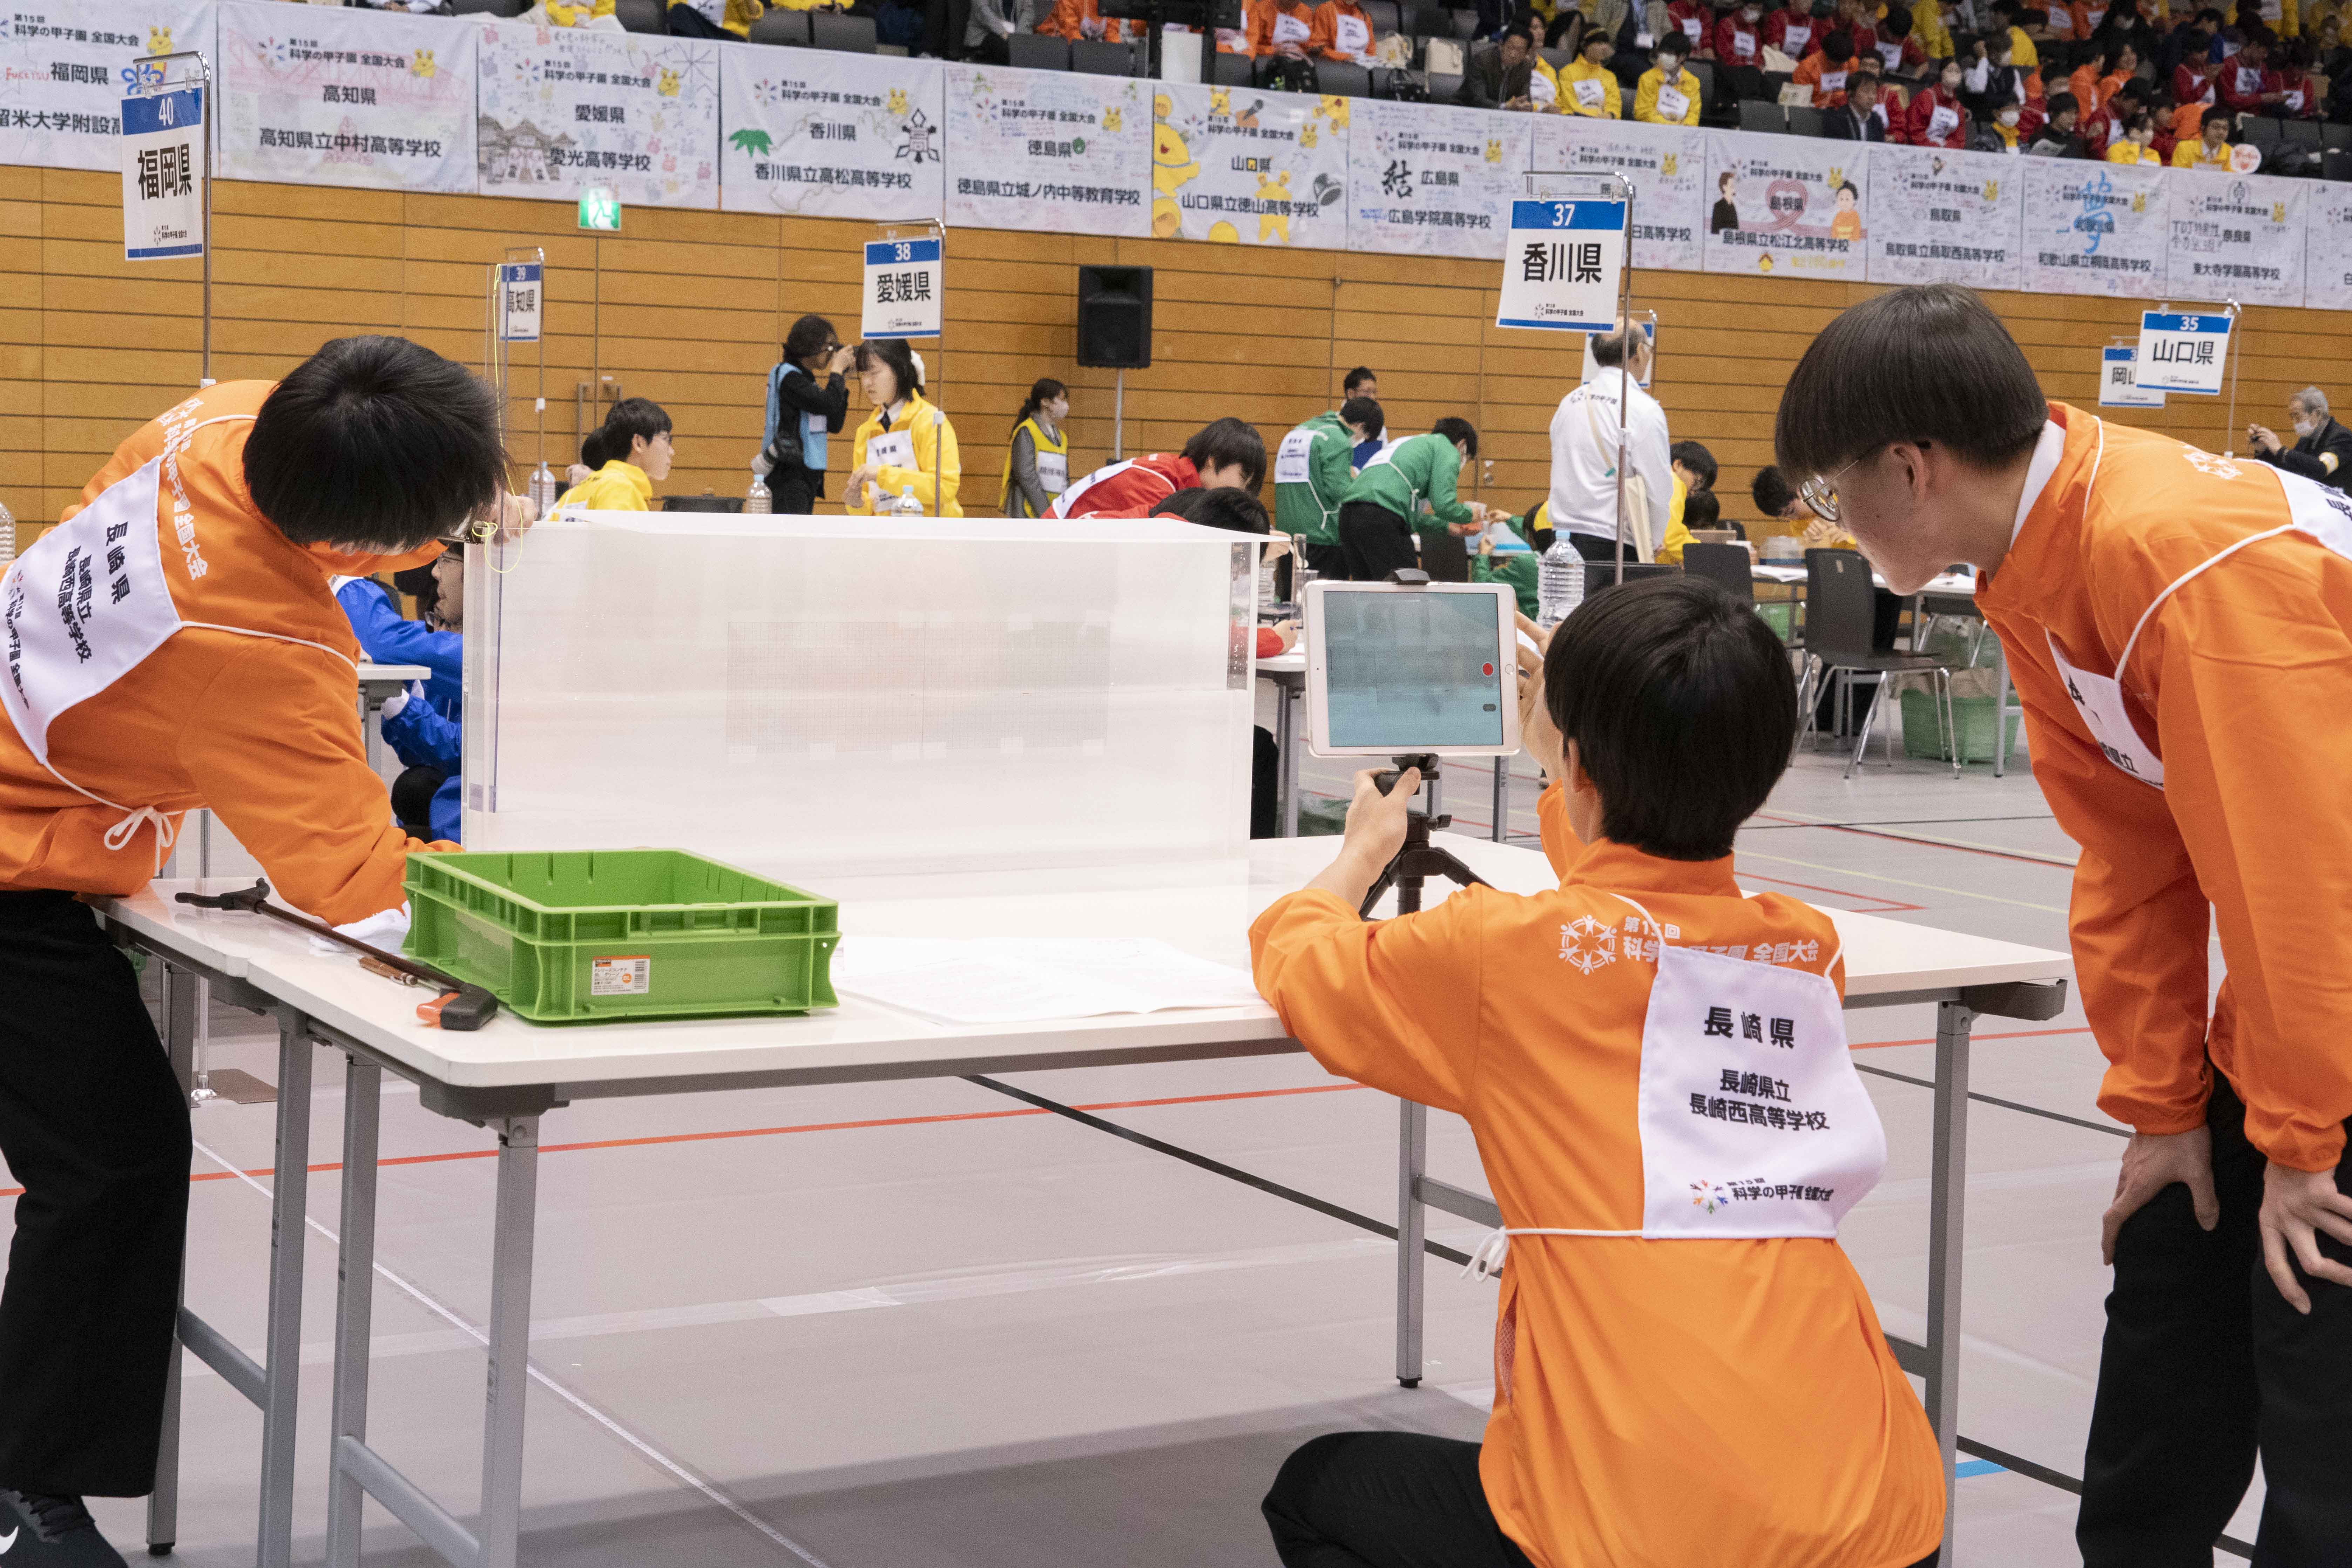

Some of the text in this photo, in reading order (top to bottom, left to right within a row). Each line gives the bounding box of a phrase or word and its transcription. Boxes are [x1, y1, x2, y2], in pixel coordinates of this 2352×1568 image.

[14, 14, 45, 23] 第15回
[14, 24, 139, 47] 科学の甲子園 全国大会
[290, 38, 318, 48] 第15回
[290, 48, 405, 68] 科学の甲子園 全国大会
[545, 60, 570, 68] 第15回
[51, 62, 108, 85] 福岡県
[545, 69, 651, 88] 科学の甲子園 全国大会
[782, 80, 805, 88] 第15回
[323, 85, 376, 105] 高知県
[782, 90, 881, 106] 科学の甲子園 全国大会
[159, 97, 173, 126] 40
[575, 104, 626, 123] 愛媛県
[1002, 109, 1095, 124] 科学の甲子園 全国大会
[810, 123, 856, 141] 香川県
[1208, 125, 1294, 141] 科学の甲子園 全国大会
[260, 128, 441, 157] 高知県立中村高等学校
[1028, 140, 1071, 157] 徳島県
[1398, 141, 1479, 155] 科学の甲子園 全国大会
[549, 149, 650, 172] 愛光高等学校
[1232, 156, 1271, 172] 山口県
[1580, 154, 1657, 169] 科学の甲子園 全国大会
[137, 143, 192, 200] 福岡県
[755, 163, 911, 189] 香川県立高松高等学校
[1381, 160, 1412, 198] 結
[1421, 171, 1459, 186] 広島県
[958, 178, 1140, 205] 徳島県立城ノ内中等教育学校
[1182, 193, 1319, 217] 山口県立徳山高等学校
[1770, 196, 1803, 211] 島根県
[1388, 210, 1492, 229] 広島学院高等学校
[1552, 203, 1575, 226] 37
[1625, 224, 1691, 241] 日高等学校
[1723, 230, 1849, 252] 島根県立松江北高等学校
[895, 243, 911, 261] 38
[1886, 242, 2005, 262] 鳥取県立鳥取西高等学校
[1523, 242, 1602, 284] 香川県
[2194, 263, 2280, 280] 東大寺学園高等学校
[878, 271, 931, 303] 愛媛県
[2179, 316, 2199, 331] 35
[2152, 339, 2214, 365] 山口県
[174, 513, 208, 581] 全国大会
[77, 554, 92, 624] 長崎県立
[58, 545, 92, 663] 長崎西高等学校
[6, 598, 21, 662] 科学の甲子園
[1753, 939, 1819, 965] 全国大会
[1704, 1006, 1795, 1049] 長崎県
[1720, 1069, 1791, 1103] 長崎県立
[1690, 1093, 1830, 1131] 長崎西高等学校
[1732, 1185, 1805, 1201] 科学の甲子園
